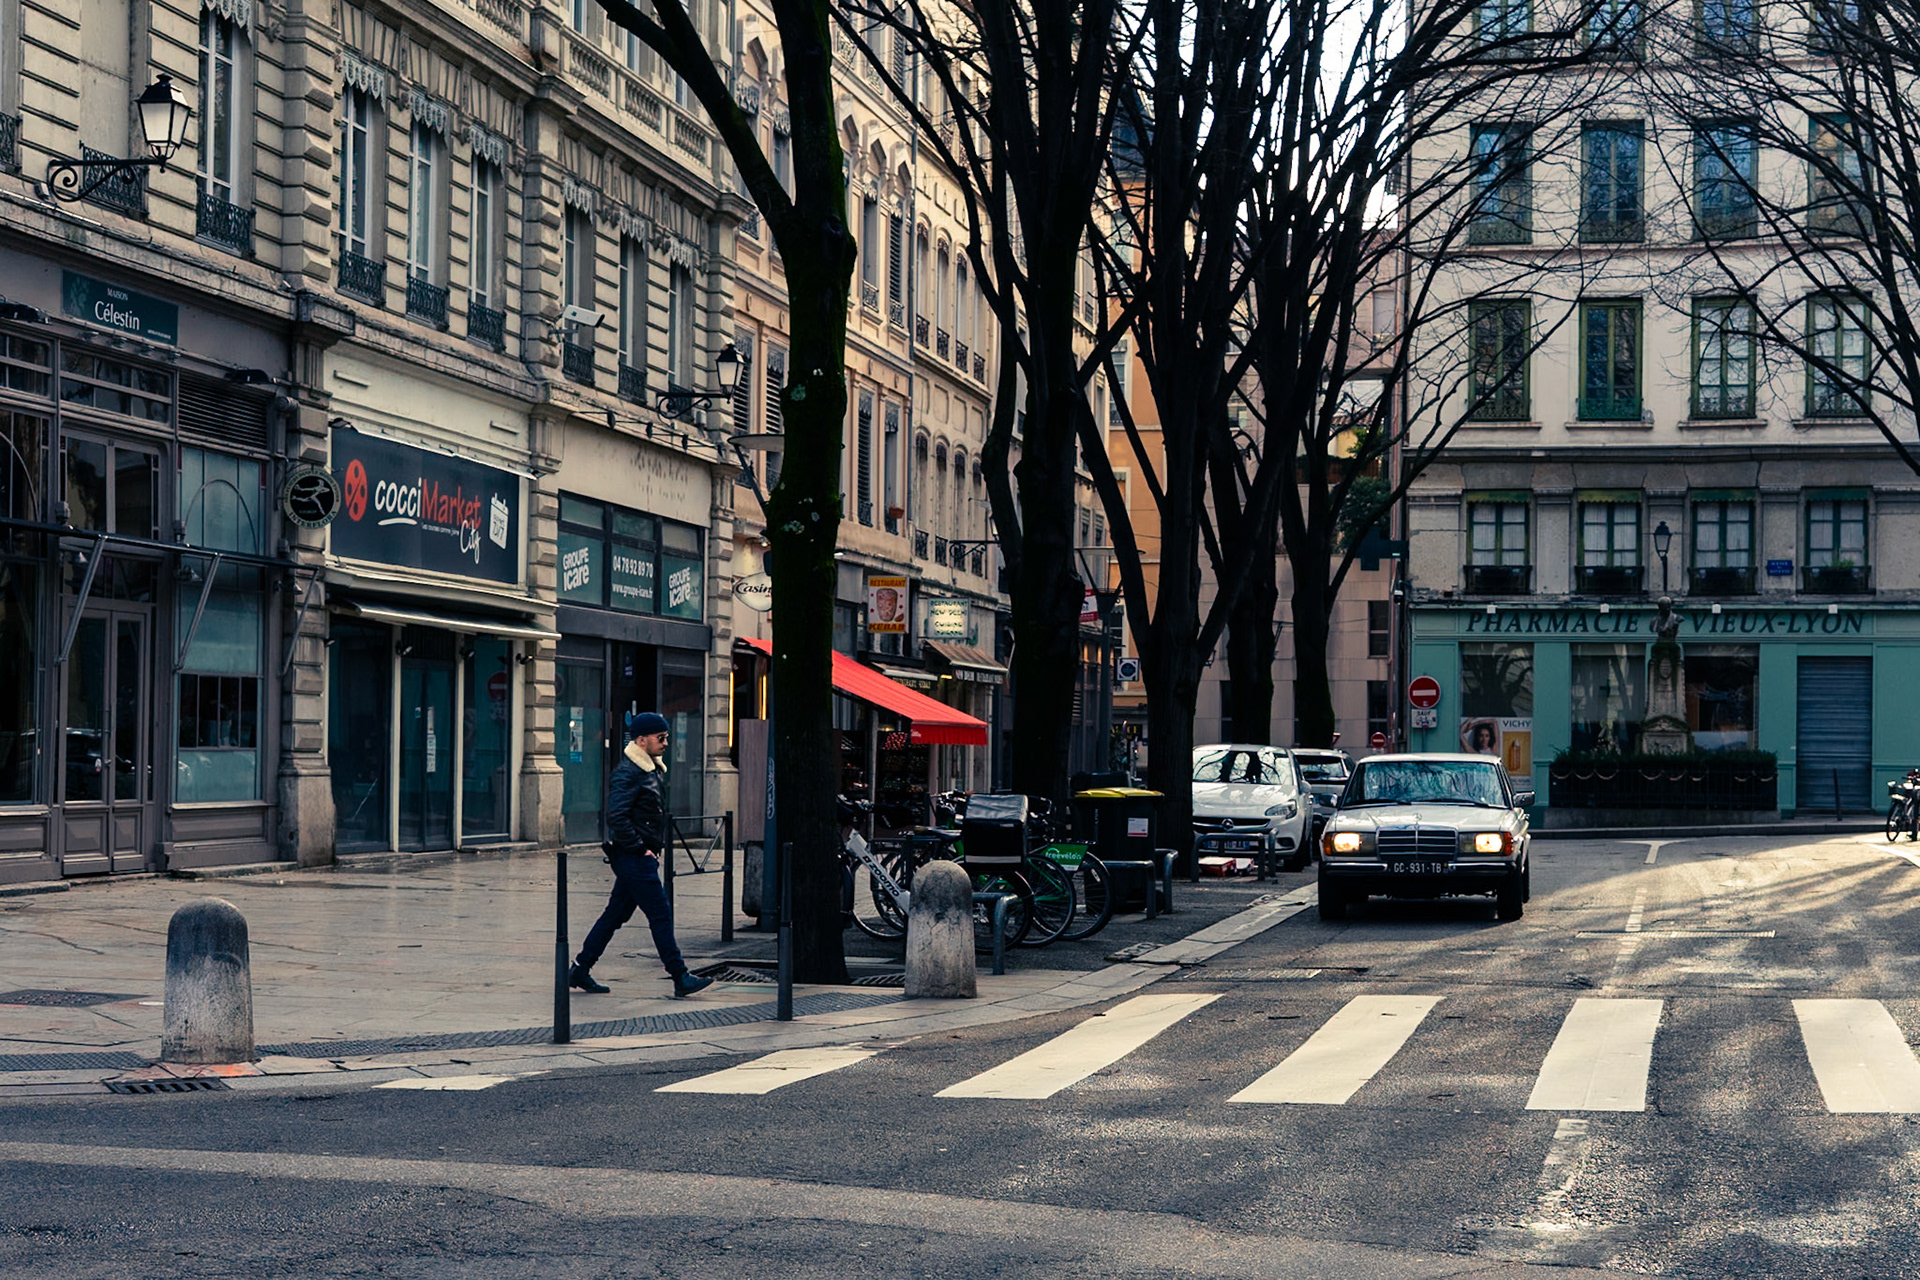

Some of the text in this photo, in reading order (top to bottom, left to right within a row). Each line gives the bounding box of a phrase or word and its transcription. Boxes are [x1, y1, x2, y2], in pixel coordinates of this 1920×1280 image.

[107, 288, 128, 300] MAISON
[95, 301, 139, 330] Célestin
[375, 476, 482, 529] cocciMarket
[289, 511, 337, 528] INTERFLORA
[460, 519, 481, 565] City
[562, 547, 588, 570] GROUPE
[613, 555, 621, 572] 04
[622, 557, 630, 574] 78
[668, 567, 690, 588] GROUPE
[869, 578, 906, 587] RESTAURANT
[735, 582, 772, 594] Casin
[868, 623, 906, 631] KEBAB
[1466, 611, 1641, 633] PHARMACIE
[1692, 611, 1864, 633] VIEUX-LYON
[1503, 720, 1531, 728] VICHY
